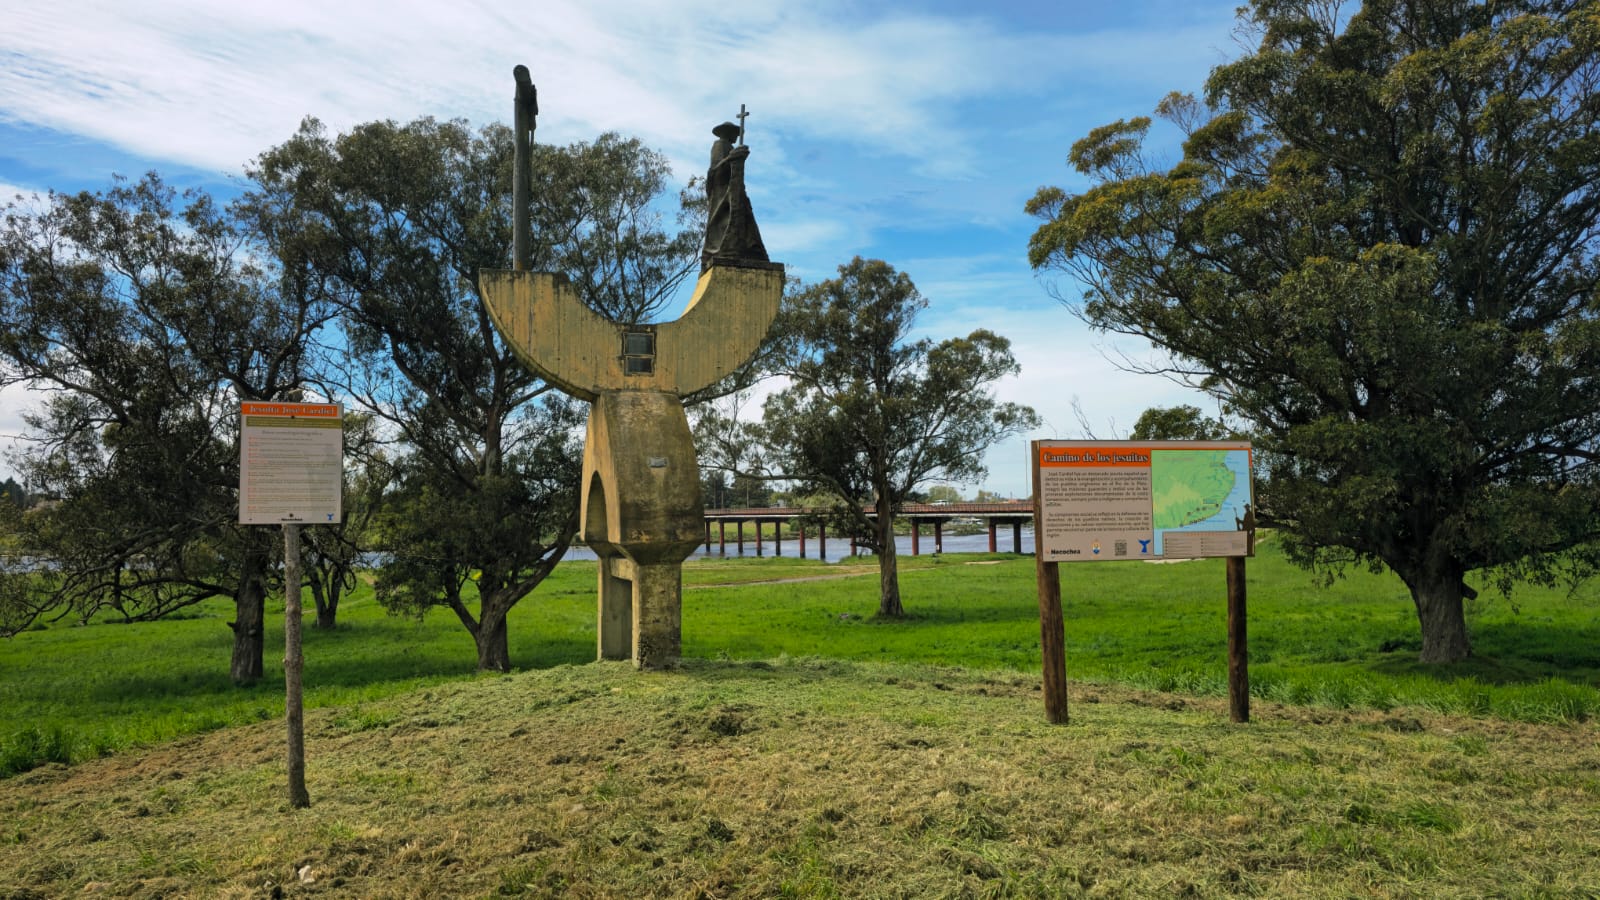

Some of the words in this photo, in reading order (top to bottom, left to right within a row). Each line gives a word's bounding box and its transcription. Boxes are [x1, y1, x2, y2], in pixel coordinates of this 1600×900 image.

[250, 405, 279, 413] Jesuita
[282, 406, 300, 414] José
[1043, 452, 1080, 462] Camino
[1082, 452, 1094, 462] de
[1098, 452, 1110, 462] los
[1112, 452, 1148, 464] jesuitas
